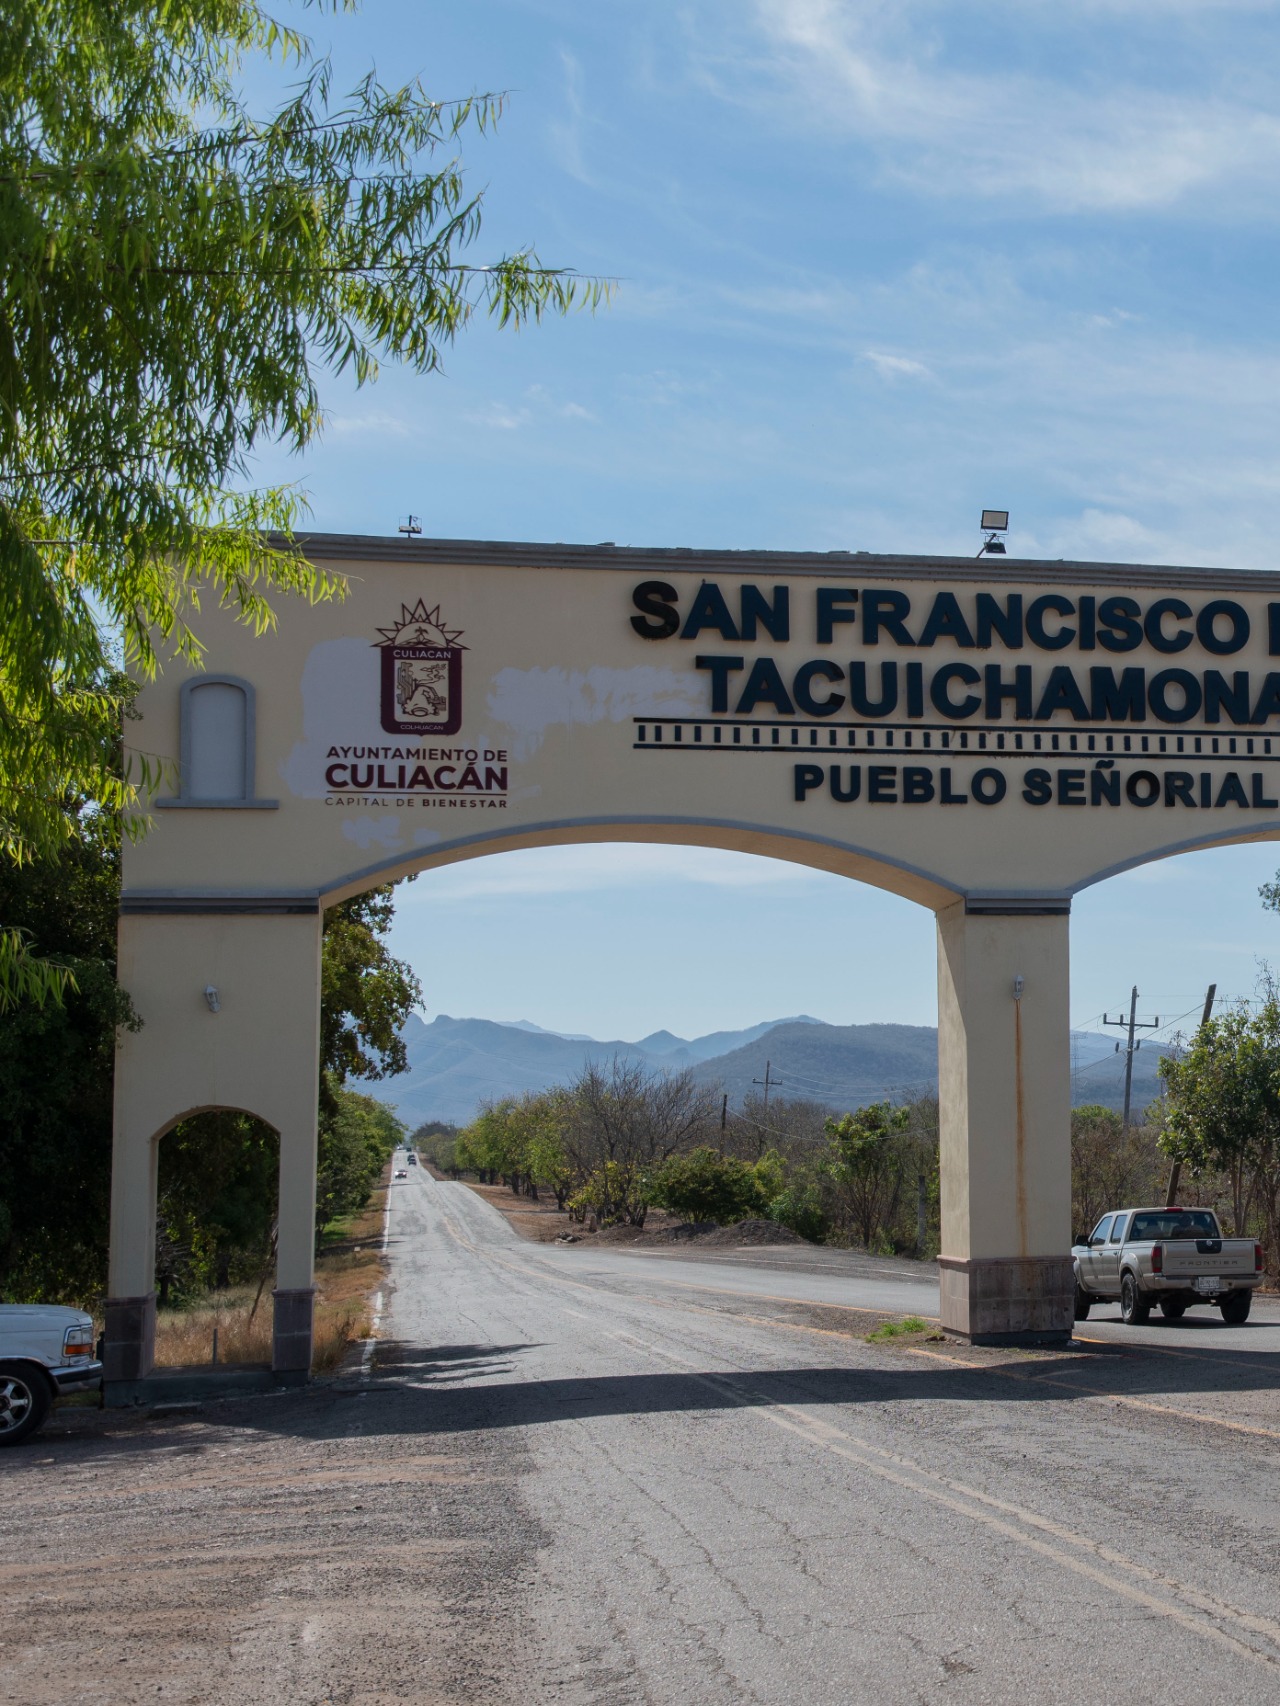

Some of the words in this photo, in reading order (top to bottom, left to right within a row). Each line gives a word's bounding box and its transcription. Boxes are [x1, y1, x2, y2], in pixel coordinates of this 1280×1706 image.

[630, 580, 790, 642] SAN
[816, 587, 1251, 656] FRANCISCO
[393, 649, 452, 659] CULIACAN
[326, 745, 478, 763] AYUNTAMIENTO
[483, 749, 507, 763] DE
[325, 761, 508, 791] CULIACÁN
[794, 764, 1007, 806] PUEBLO
[1022, 759, 1279, 809] SEÑORIAL
[325, 797, 389, 807] CAPITAL
[396, 798, 415, 808] DE
[422, 799, 507, 809] BIENESTAR
